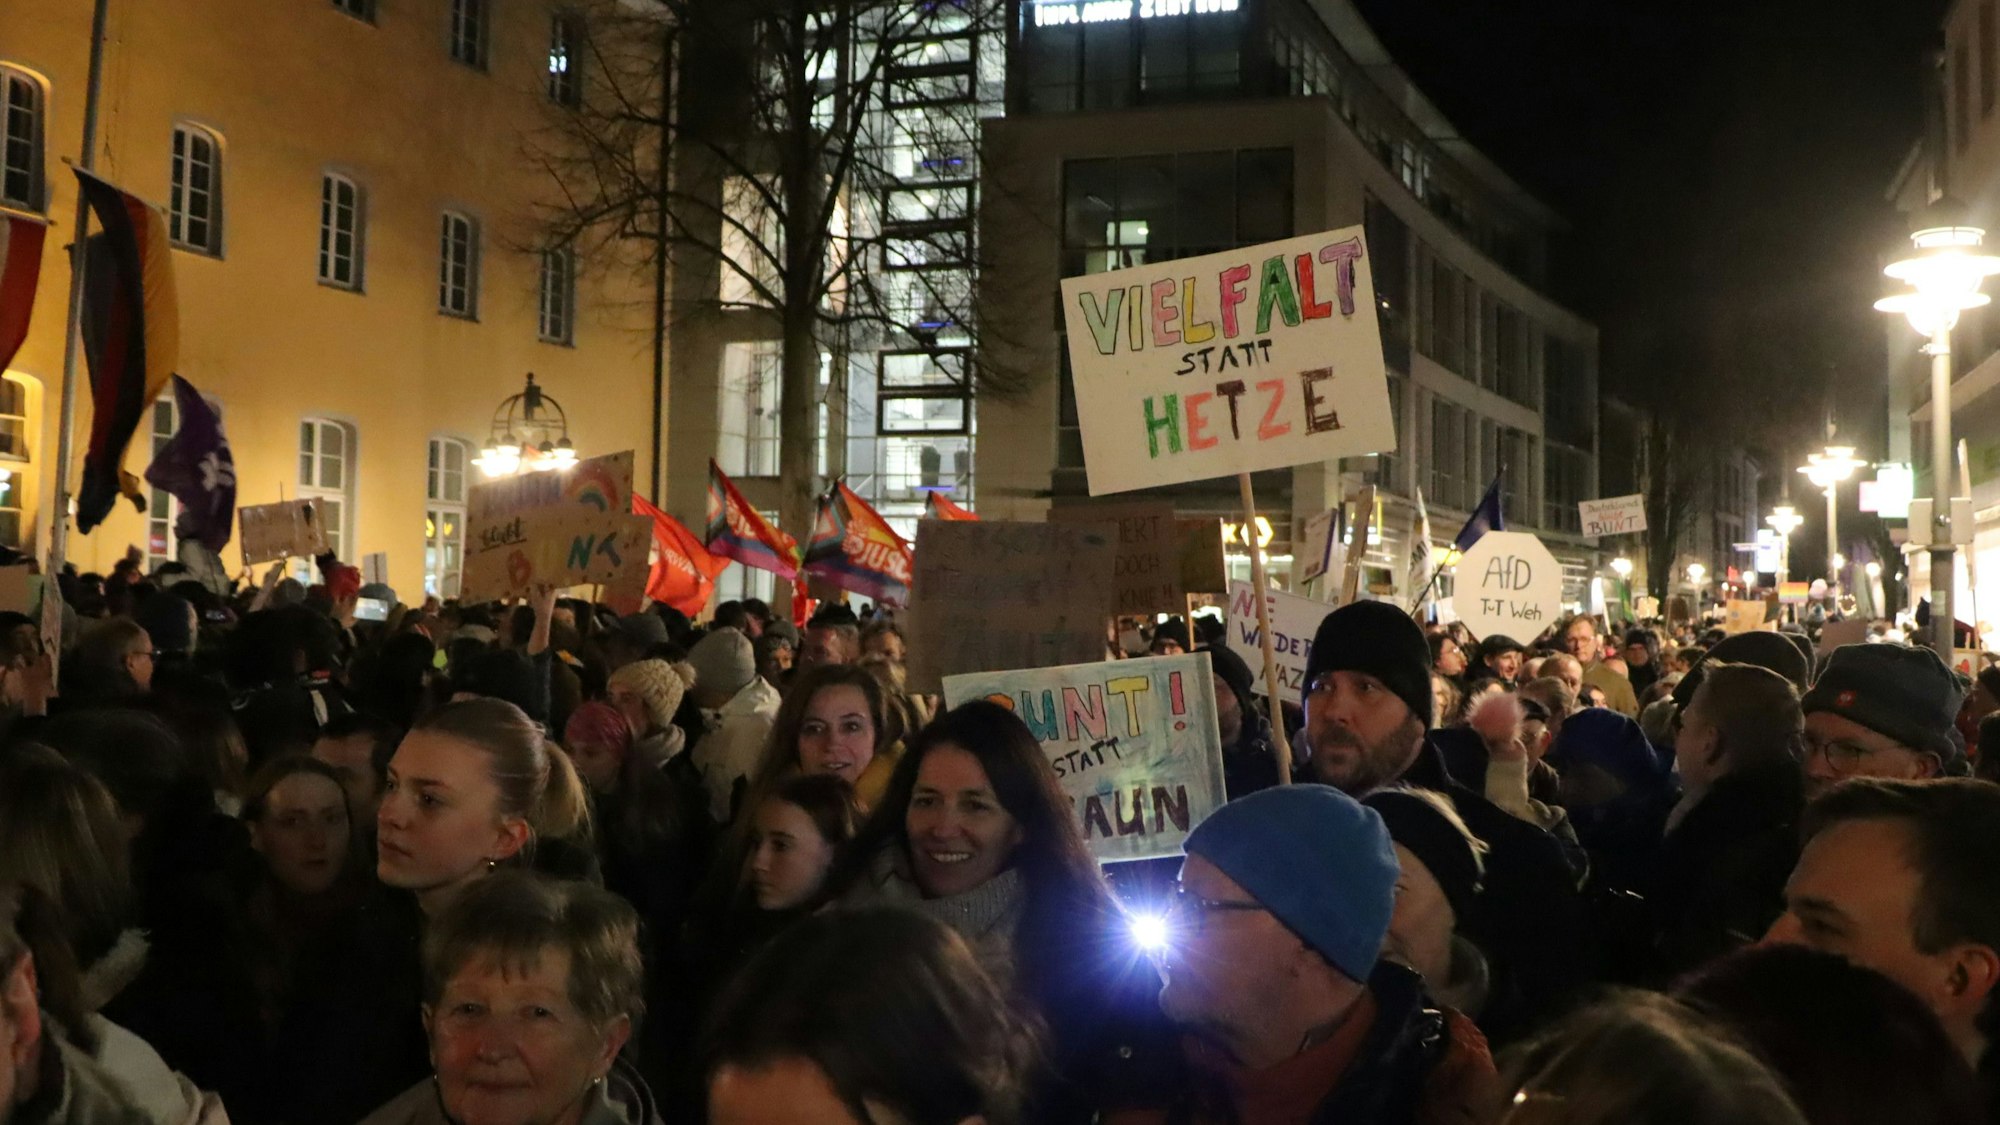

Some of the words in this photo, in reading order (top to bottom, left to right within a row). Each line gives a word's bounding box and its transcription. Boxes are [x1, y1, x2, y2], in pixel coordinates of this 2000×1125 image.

[1078, 236, 1363, 355] VIELFALT
[1174, 339, 1273, 376] STATT
[1143, 366, 1345, 459] HETZE
[1587, 515, 1639, 536] BUNT
[1481, 555, 1532, 591] AfD
[1510, 600, 1542, 621] Weh
[1052, 736, 1121, 778] STATT
[1069, 784, 1190, 840] AUN
